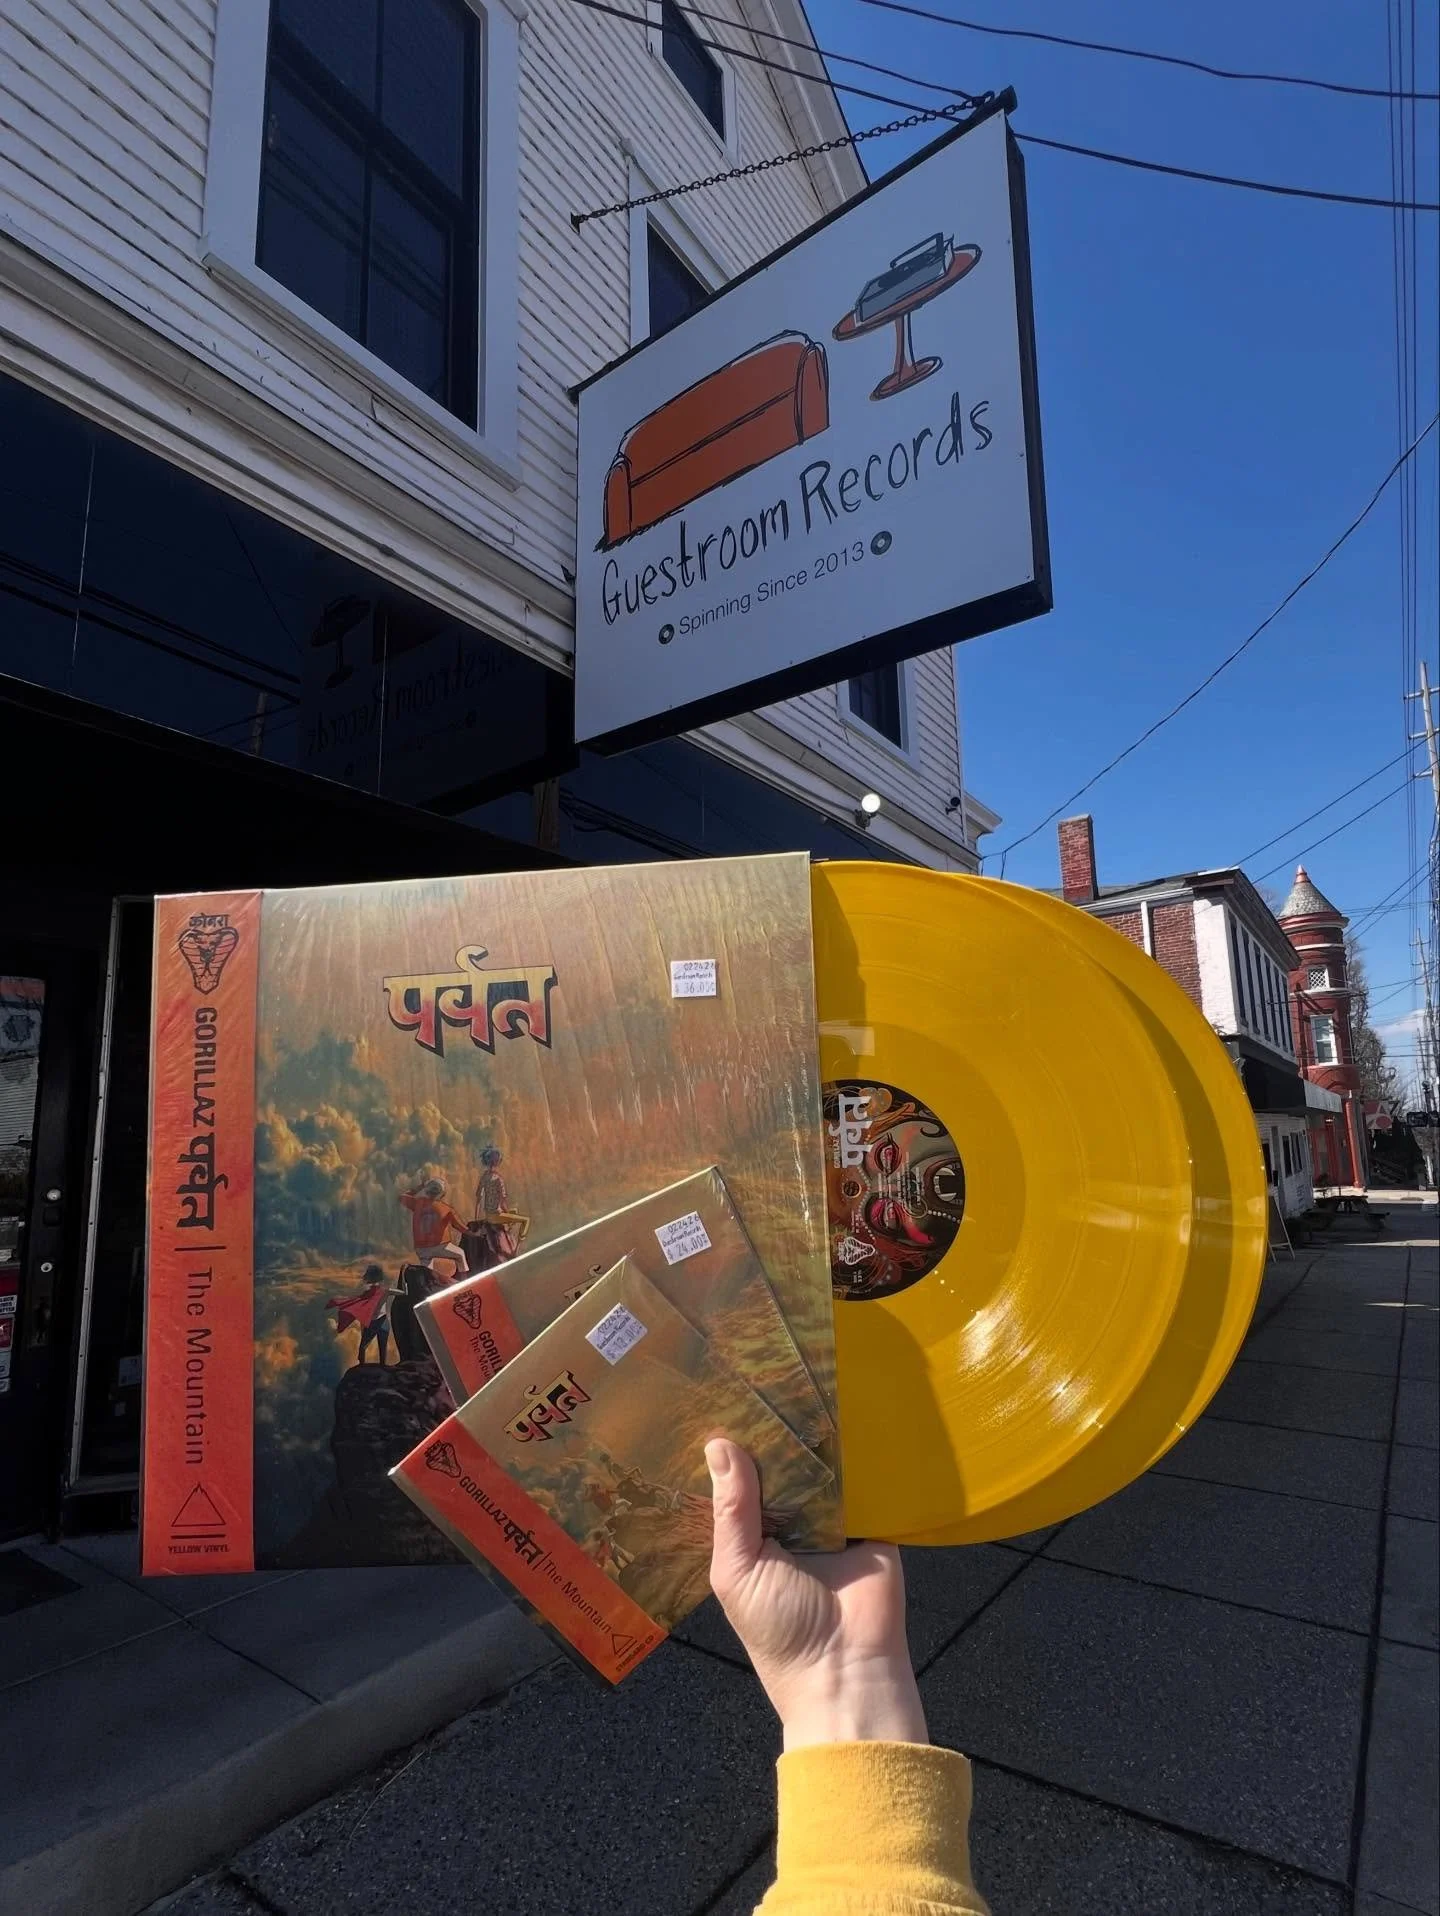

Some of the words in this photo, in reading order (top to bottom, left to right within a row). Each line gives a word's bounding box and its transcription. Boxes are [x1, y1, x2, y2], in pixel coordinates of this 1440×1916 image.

[602, 499, 789, 626] Guestroom
[800, 391, 993, 534] Records
[679, 593, 752, 636] Spinning
[757, 570, 808, 602] Since
[814, 541, 865, 580] 2013
[382, 944, 559, 1058] पर्वत
[193, 1007, 218, 1128] GORILLAZ
[176, 1132, 229, 1231] पर्वत
[186, 1266, 213, 1317] The
[185, 1328, 213, 1465] Mountain
[503, 1369, 592, 1442] पर्वत
[459, 1476, 506, 1526] GORILLAZ
[542, 1556, 562, 1584] The
[561, 1580, 612, 1634] Mountain
